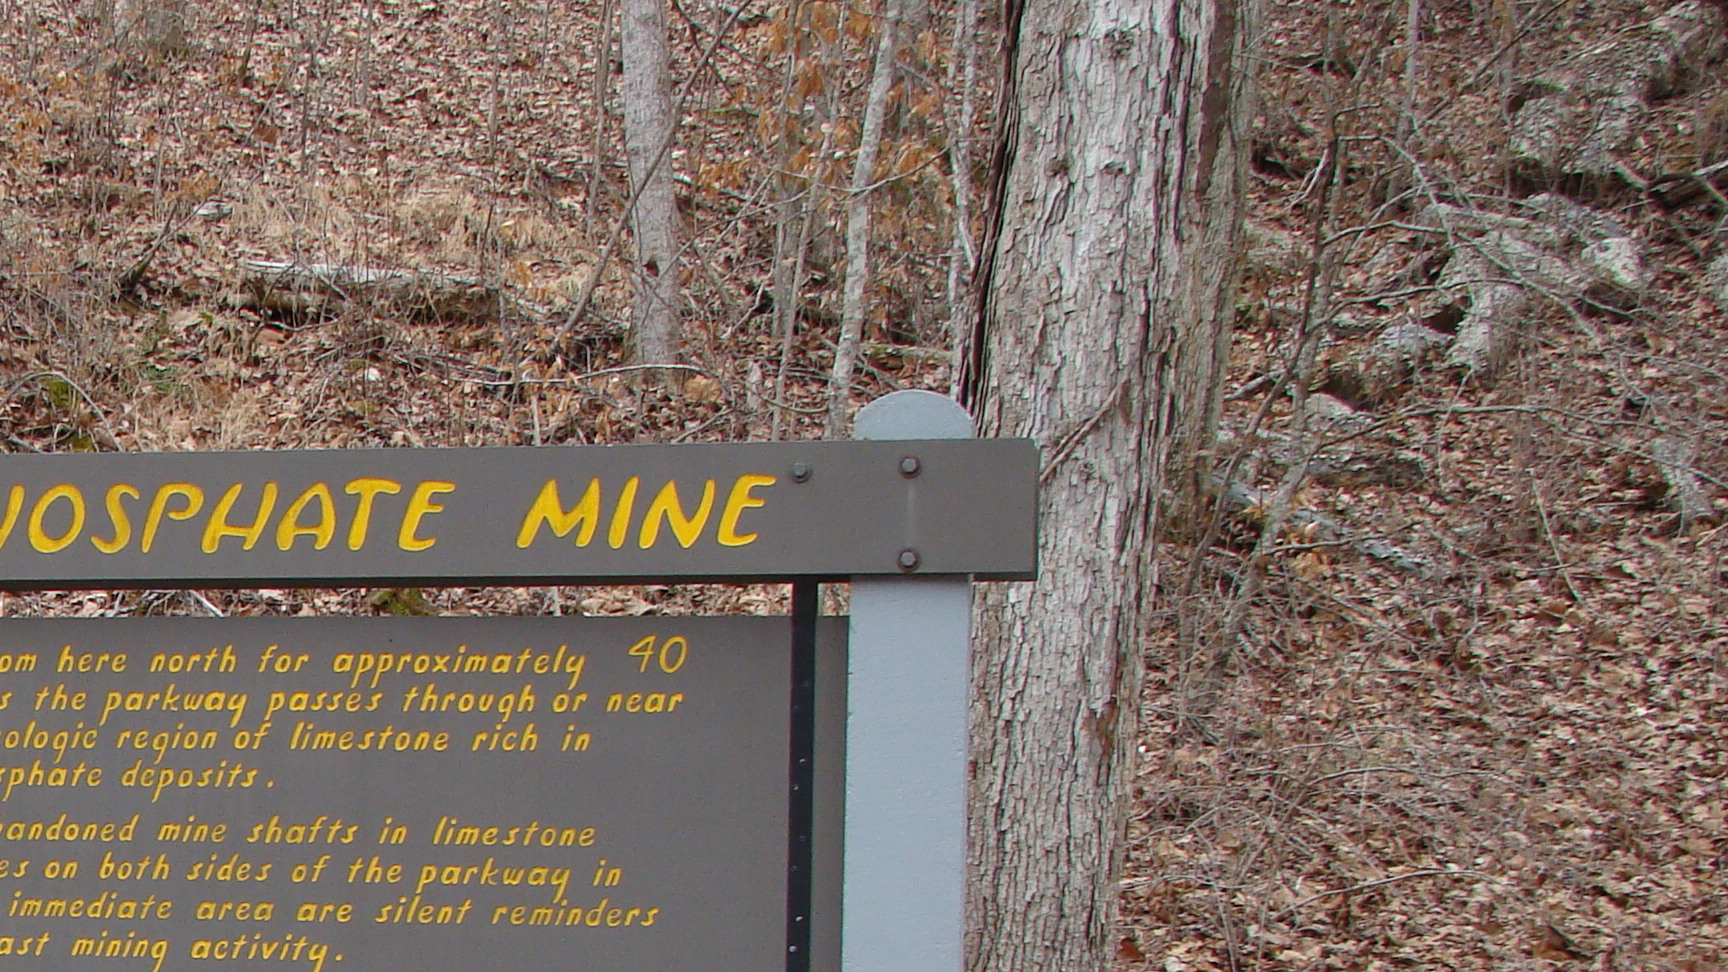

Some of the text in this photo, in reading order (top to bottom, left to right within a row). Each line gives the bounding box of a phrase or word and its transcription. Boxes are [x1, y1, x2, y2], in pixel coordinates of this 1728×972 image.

[514, 472, 778, 551] MINE
[55, 644, 128, 674] here
[148, 643, 238, 674] north
[256, 643, 311, 674] for
[331, 643, 587, 691] approximately
[626, 633, 689, 675] 40
[33, 682, 88, 711] the
[97, 682, 249, 730] parkway
[262, 690, 385, 721] passes
[401, 682, 537, 723] through
[550, 691, 589, 714] or
[605, 691, 685, 714] near
[114, 728, 219, 765] region
[232, 720, 274, 751] of
[288, 720, 450, 753] limestone
[470, 721, 540, 753] rich
[560, 722, 592, 752] in
[155, 814, 228, 843] mine
[245, 814, 360, 845] shafts
[377, 815, 409, 845] in
[431, 815, 597, 848] limestone
[42, 859, 80, 880] on
[97, 850, 171, 881] both
[184, 852, 272, 883] sides
[289, 852, 332, 884] of
[346, 854, 403, 884] the
[414, 856, 572, 904] parkway
[591, 857, 623, 887] in
[6, 889, 174, 921] immediate
[194, 900, 275, 922] area
[294, 901, 354, 924] are
[373, 893, 473, 924] silent
[490, 897, 660, 928] reminders
